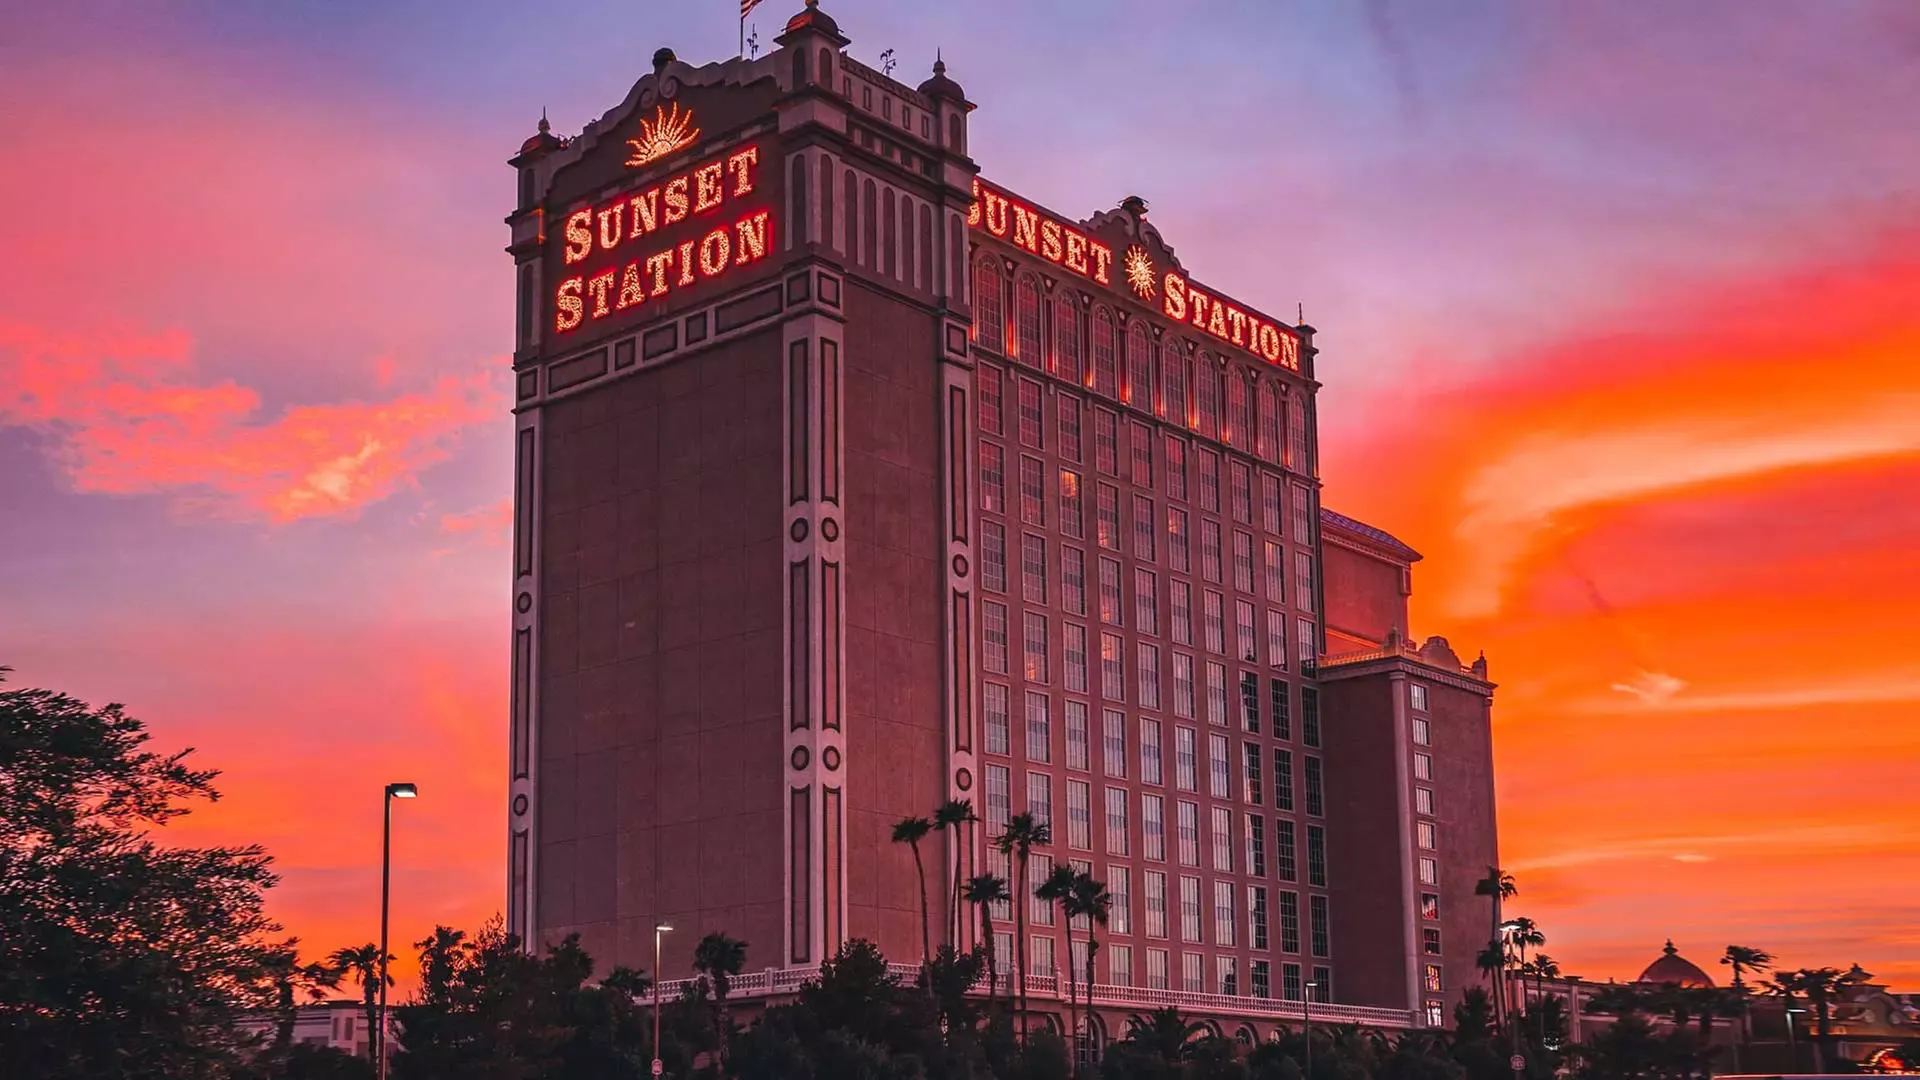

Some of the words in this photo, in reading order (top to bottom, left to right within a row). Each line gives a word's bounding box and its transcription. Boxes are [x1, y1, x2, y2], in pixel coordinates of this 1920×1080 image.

[565, 147, 758, 265] SUNSET
[556, 212, 768, 332] STATION
[1164, 273, 1299, 372] STATION
